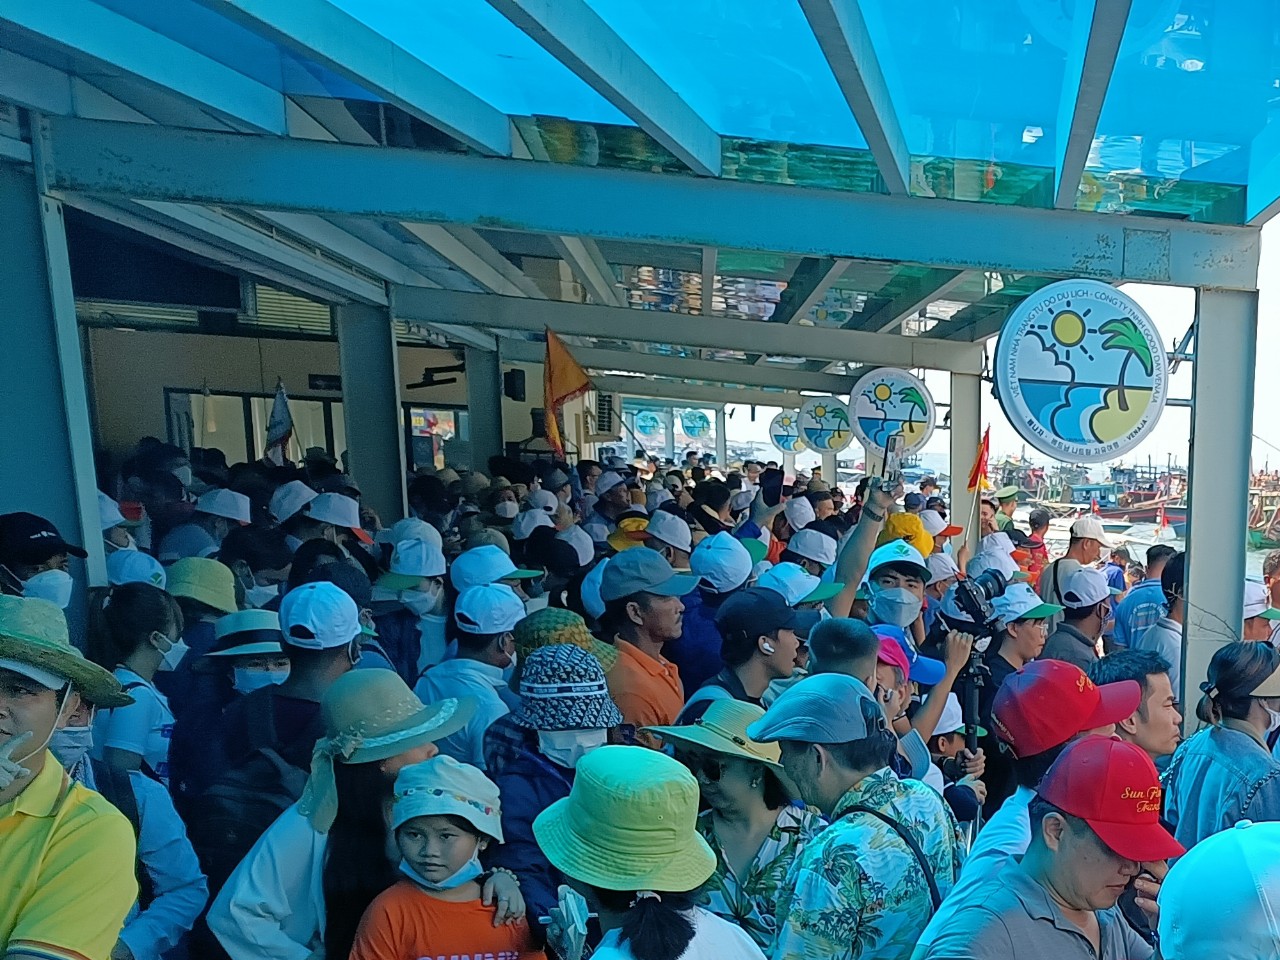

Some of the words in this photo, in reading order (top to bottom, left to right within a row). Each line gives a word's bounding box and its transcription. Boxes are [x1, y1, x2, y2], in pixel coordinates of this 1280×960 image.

[1144, 327, 1158, 354] GOOD
[1153, 355, 1162, 373] DAY
[1126, 419, 1148, 441] VENAJA
[1121, 787, 1144, 799] Sun
